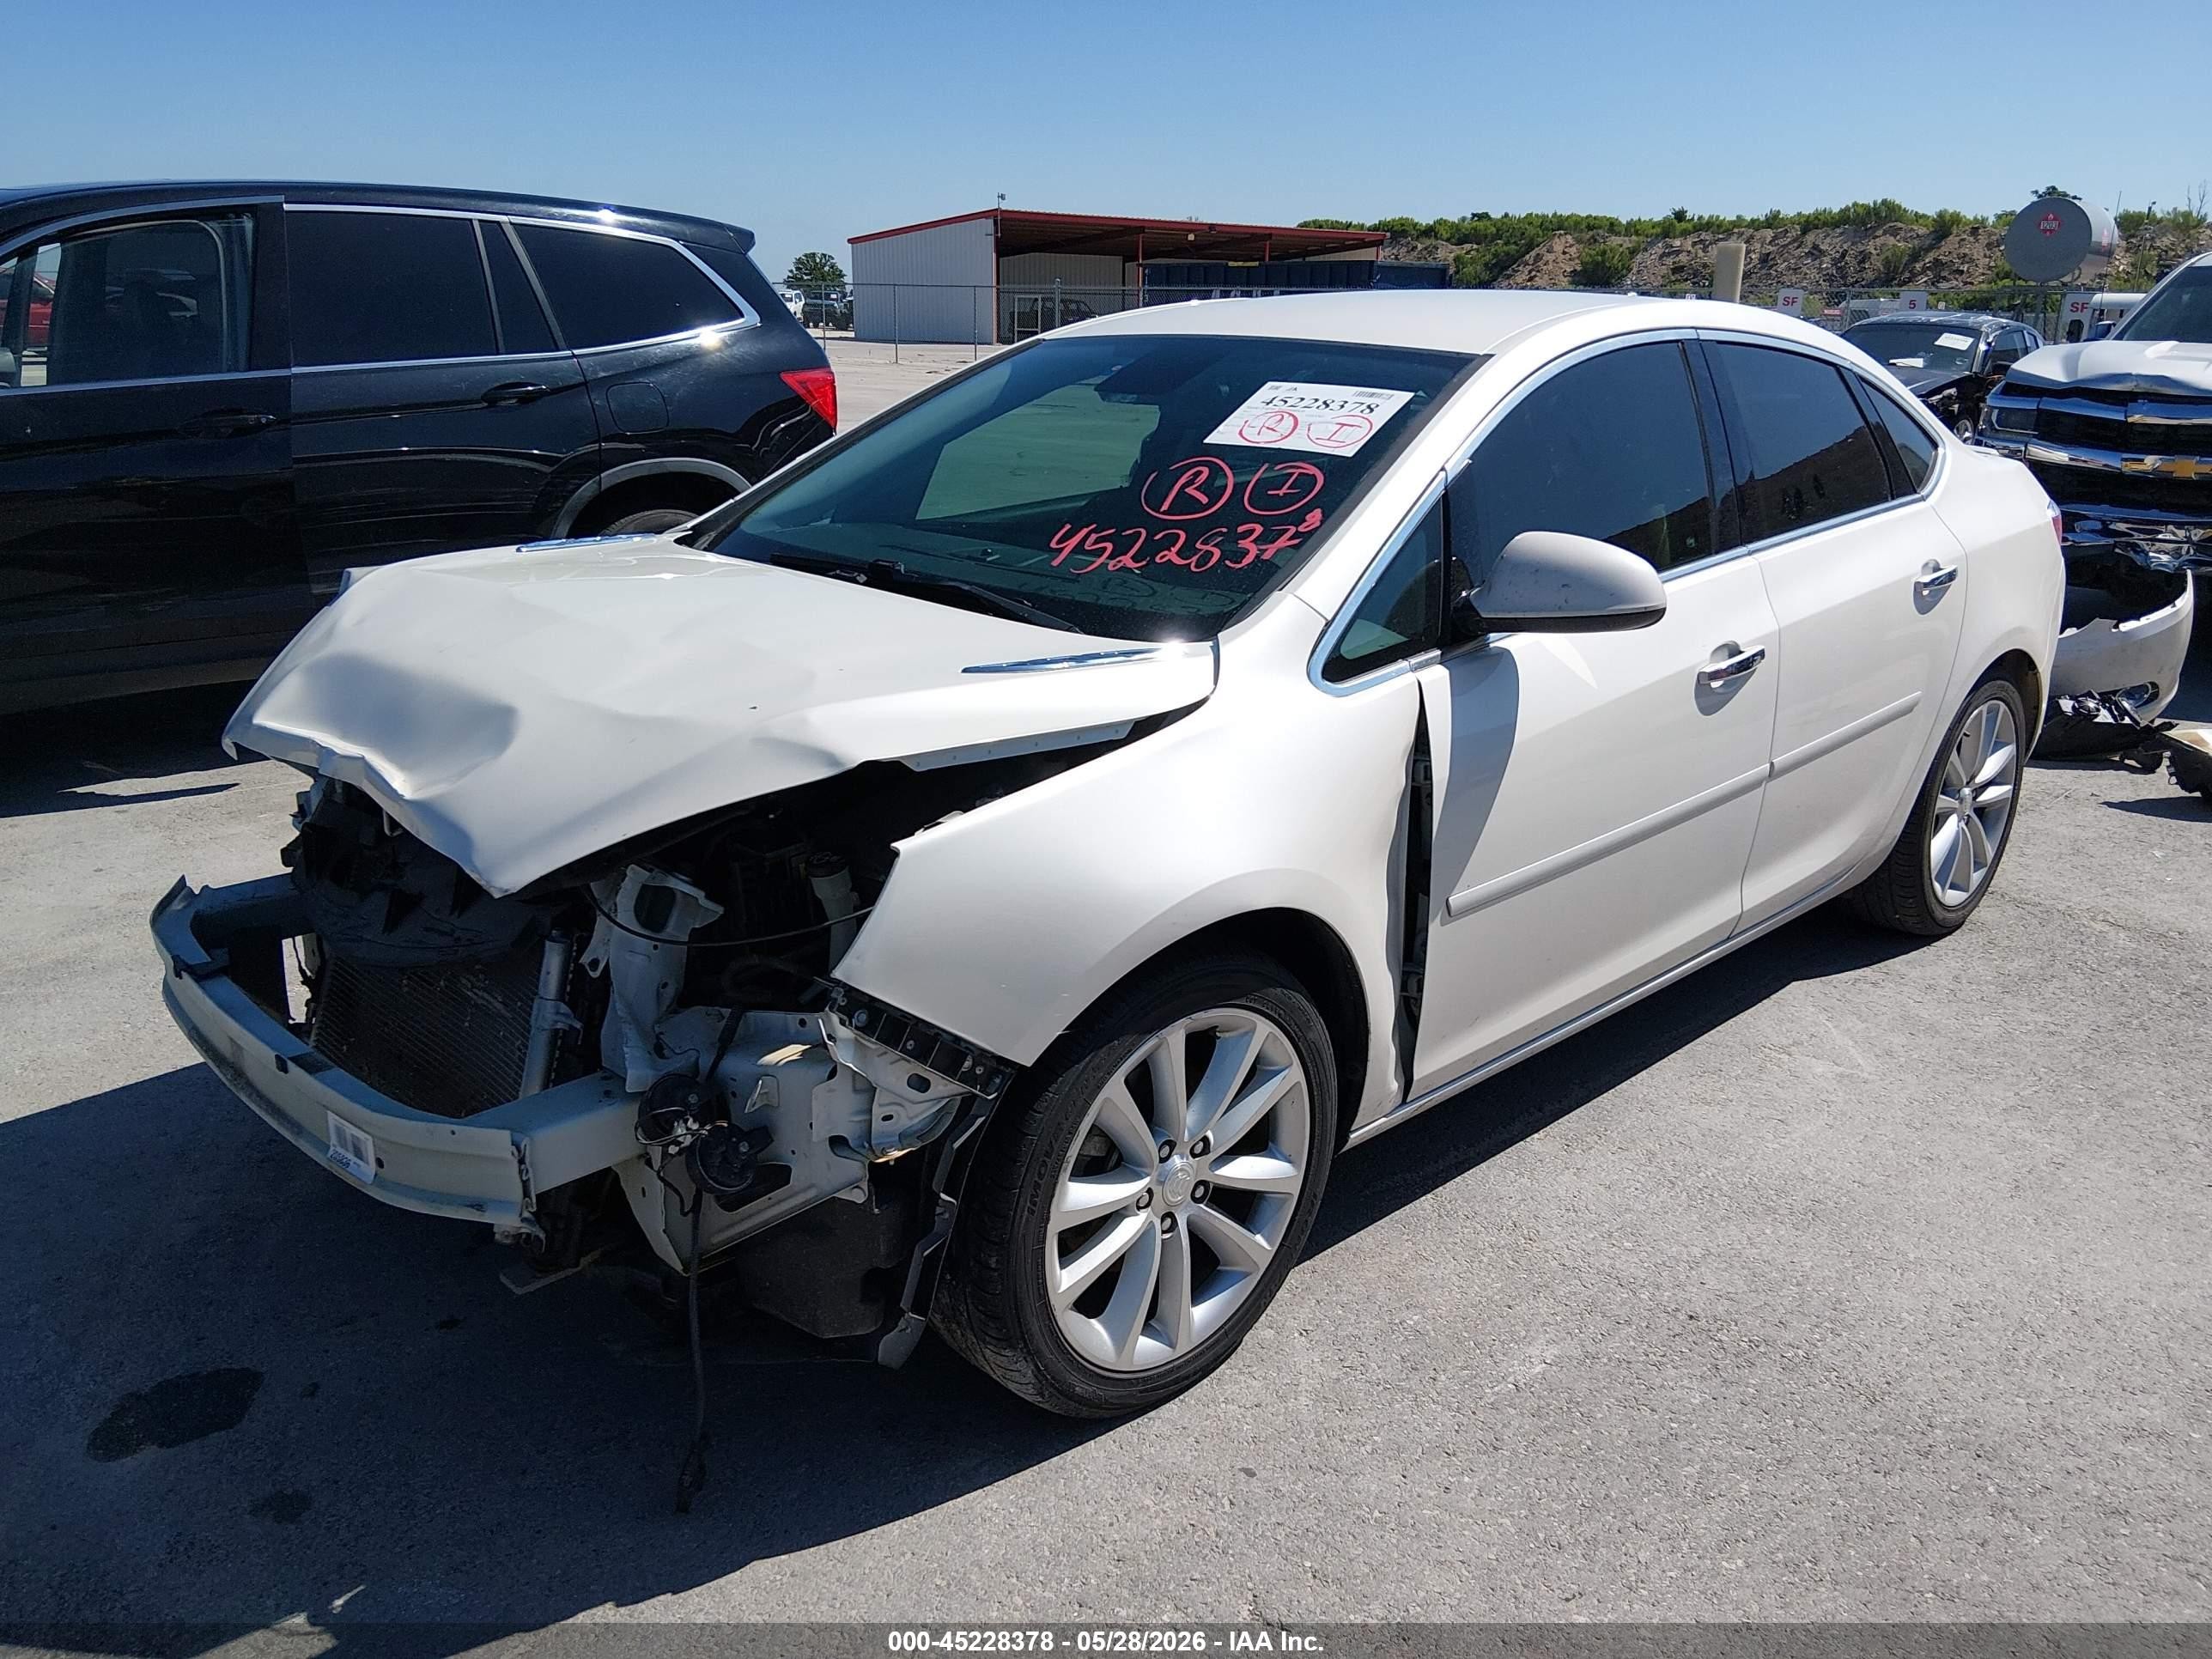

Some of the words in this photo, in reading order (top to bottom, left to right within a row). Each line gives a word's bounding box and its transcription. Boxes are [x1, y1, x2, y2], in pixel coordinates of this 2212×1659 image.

[1782, 296, 1799, 307] SF
[1908, 300, 1917, 309] 5
[2069, 301, 2089, 313] SF
[1261, 394, 1380, 416] 45228378
[1049, 507, 1323, 573] 45228378
